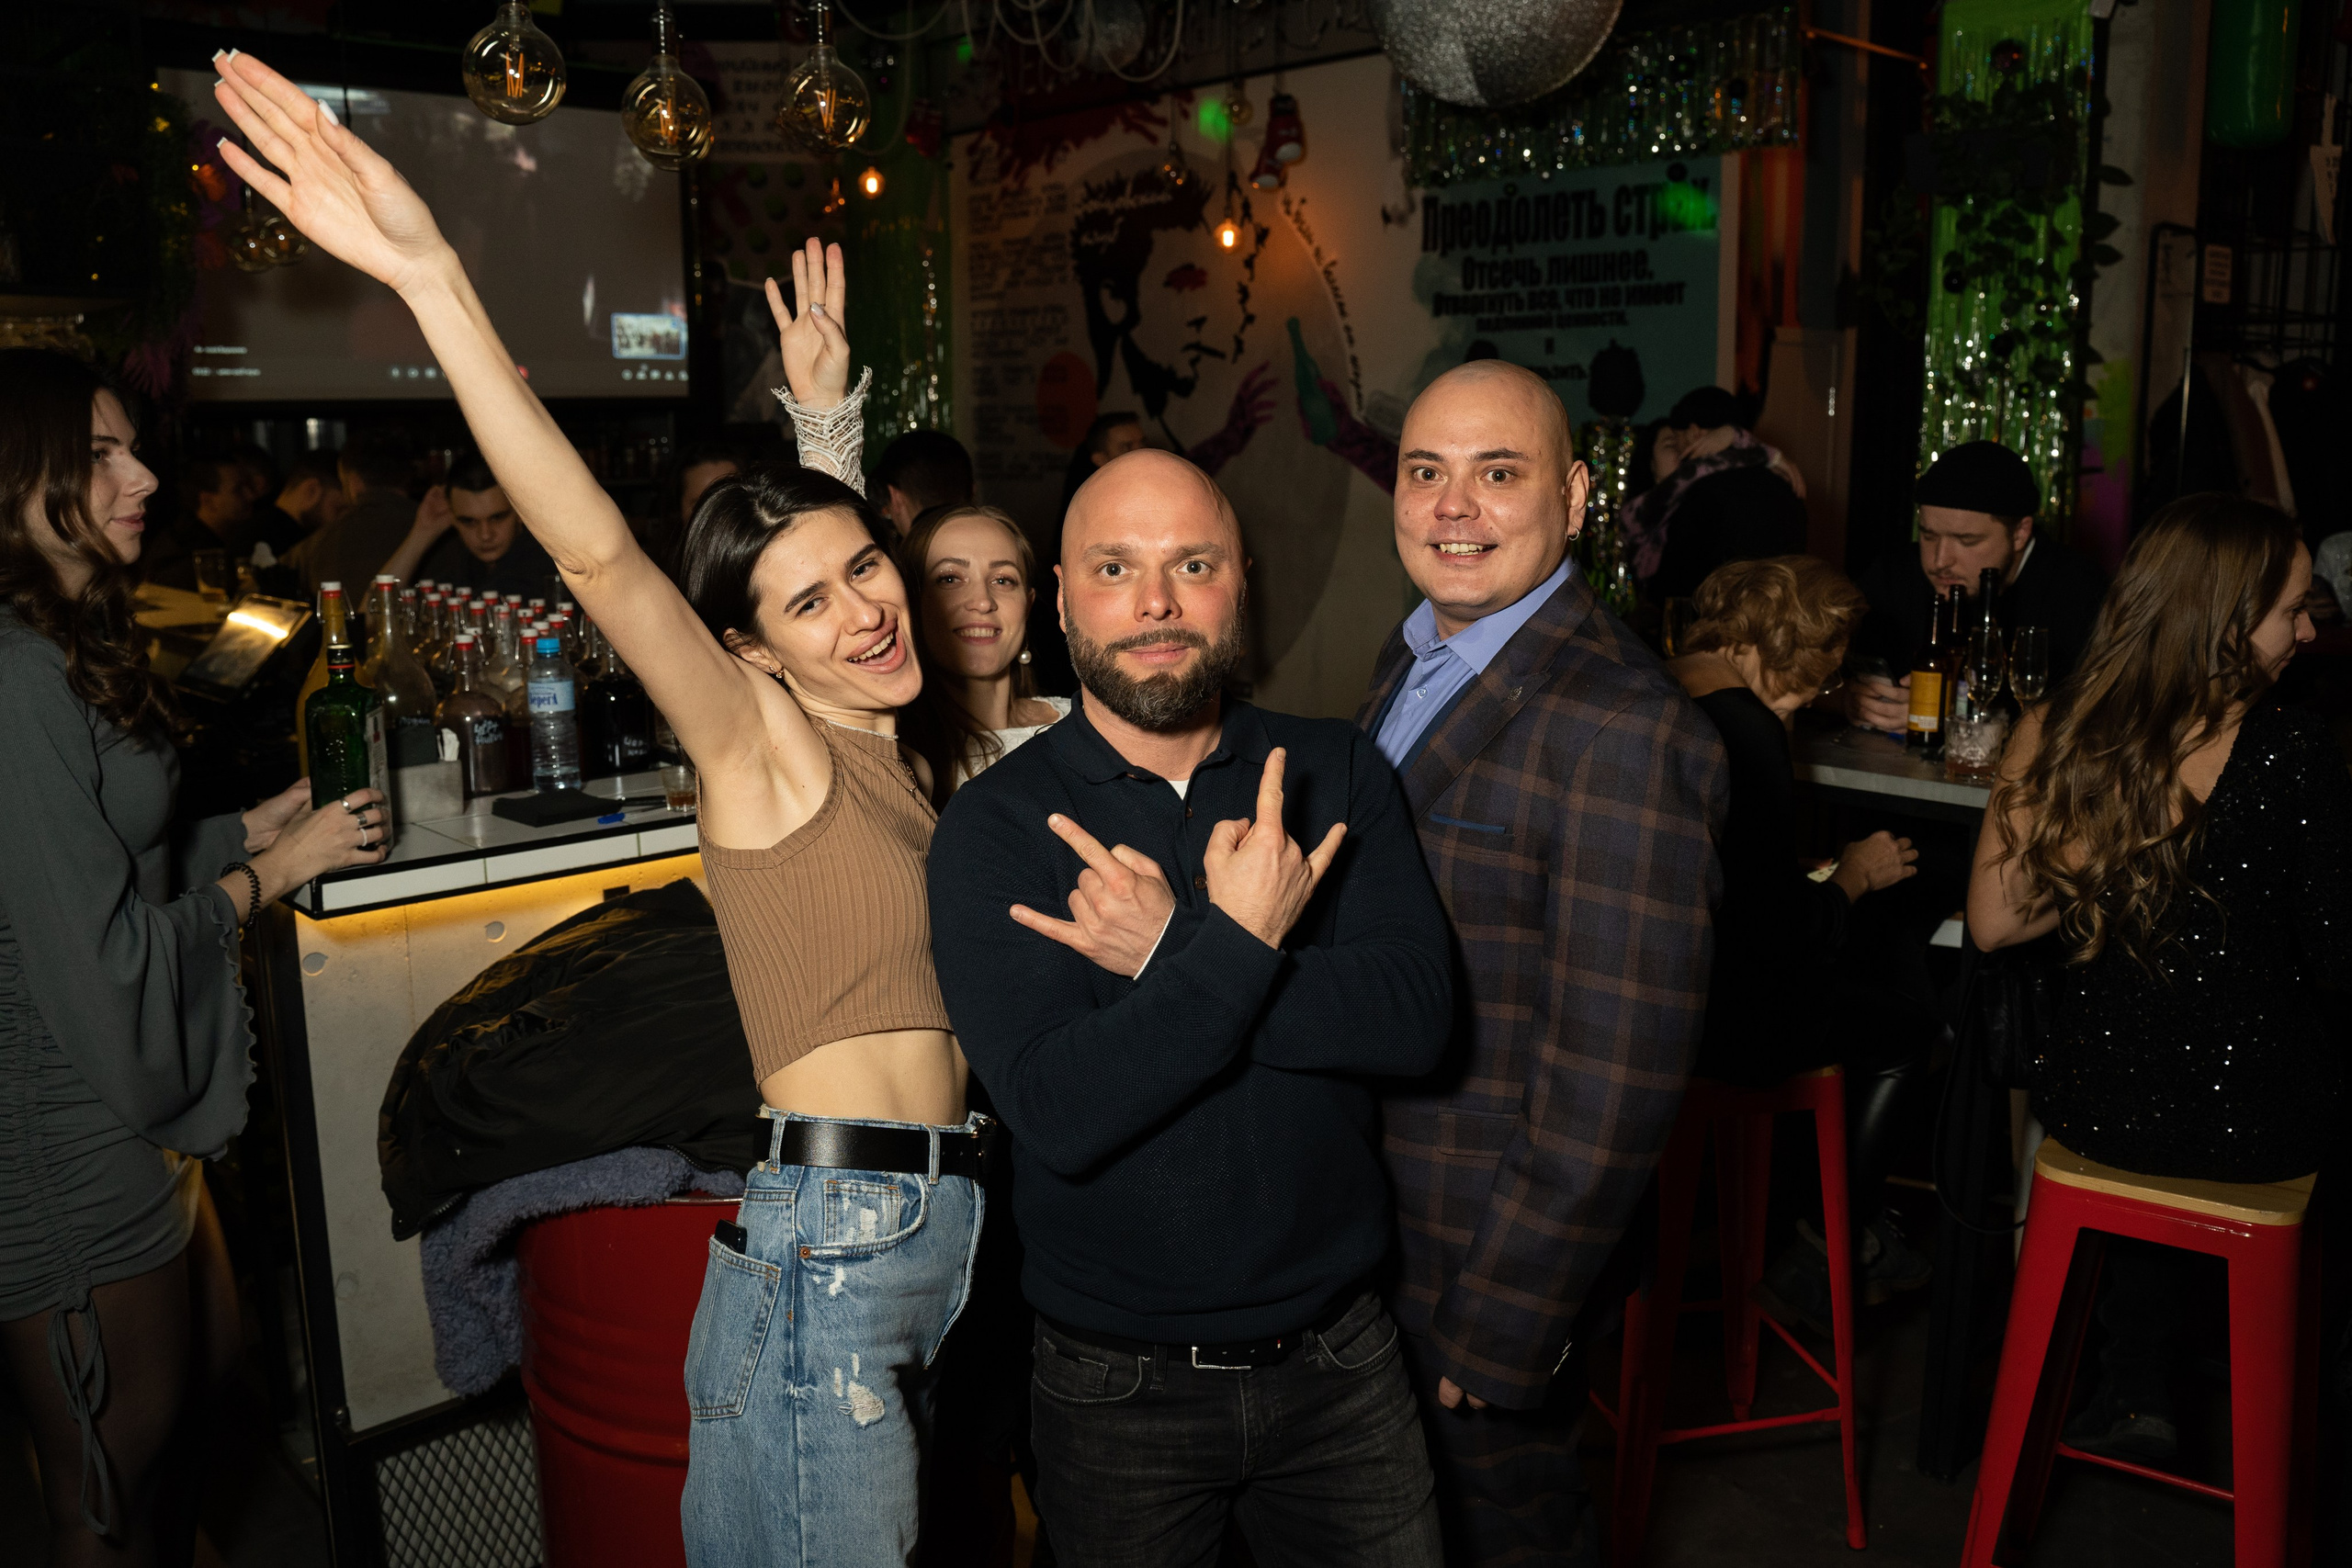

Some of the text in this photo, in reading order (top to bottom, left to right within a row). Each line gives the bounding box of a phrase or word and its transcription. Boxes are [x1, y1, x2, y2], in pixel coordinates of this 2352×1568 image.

[1422, 188, 1607, 256] Преодолеть
[1463, 249, 1654, 290] Отсечь лишнее.
[1565, 287, 1597, 309] что
[1600, 285, 1622, 307] не
[1624, 282, 1685, 306] имеет
